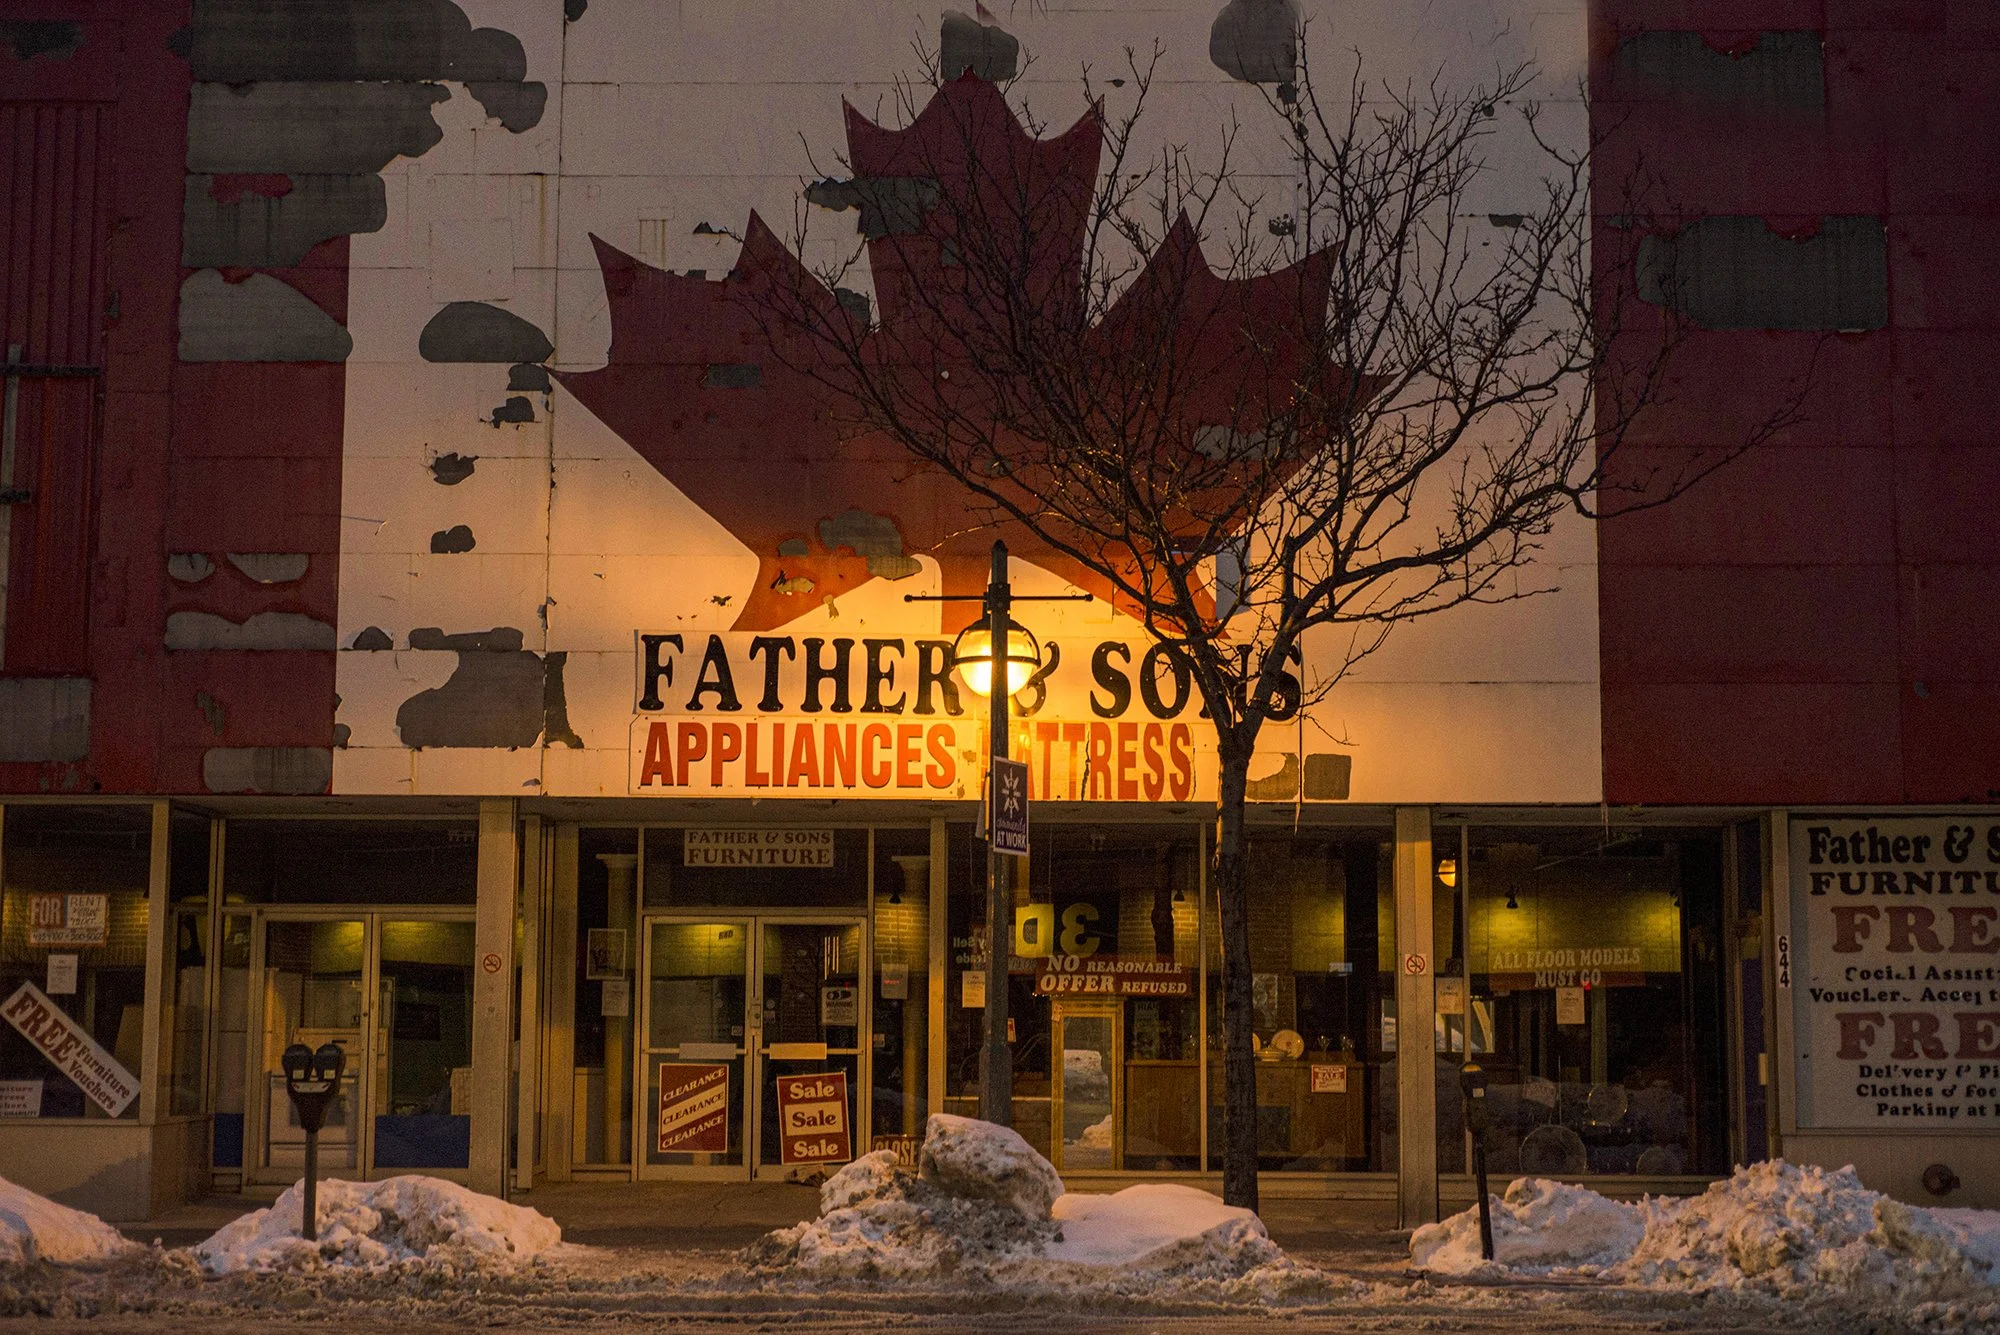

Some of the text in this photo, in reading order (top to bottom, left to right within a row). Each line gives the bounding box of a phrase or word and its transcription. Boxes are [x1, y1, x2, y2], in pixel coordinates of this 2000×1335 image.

[639, 634, 964, 716] FATHER
[640, 722, 956, 789] APPLIANCES
[980, 721, 1192, 802] ATTRESS
[688, 831, 831, 845] FATHER & SONS
[996, 831, 1027, 848] AT WORK
[1808, 825, 1931, 865] Father
[1943, 825, 1975, 863] &
[687, 847, 831, 866] FURNITURE
[30, 896, 62, 926] FOR
[1046, 954, 1081, 972] NO
[1086, 960, 1183, 974] REASONABLE
[1493, 947, 1641, 970] ALL FLOOR MODELS
[1778, 935, 1790, 987] 644
[1040, 974, 1188, 995] OFFER REFUSED
[1535, 968, 1602, 988] MUST GO
[7, 991, 82, 1065] FREE
[75, 1043, 131, 1100] Furniture
[662, 1067, 725, 1102] CLEARANCE
[68, 1060, 118, 1111] Vouchers
[790, 1081, 835, 1099] Sale
[1856, 1083, 1934, 1098] Clothes
[662, 1091, 724, 1126] CLEARANCE
[791, 1111, 837, 1128] Sale
[1967, 1104, 1987, 1117] at
[661, 1115, 724, 1150] CLEARANCE
[793, 1140, 839, 1158] Sale
